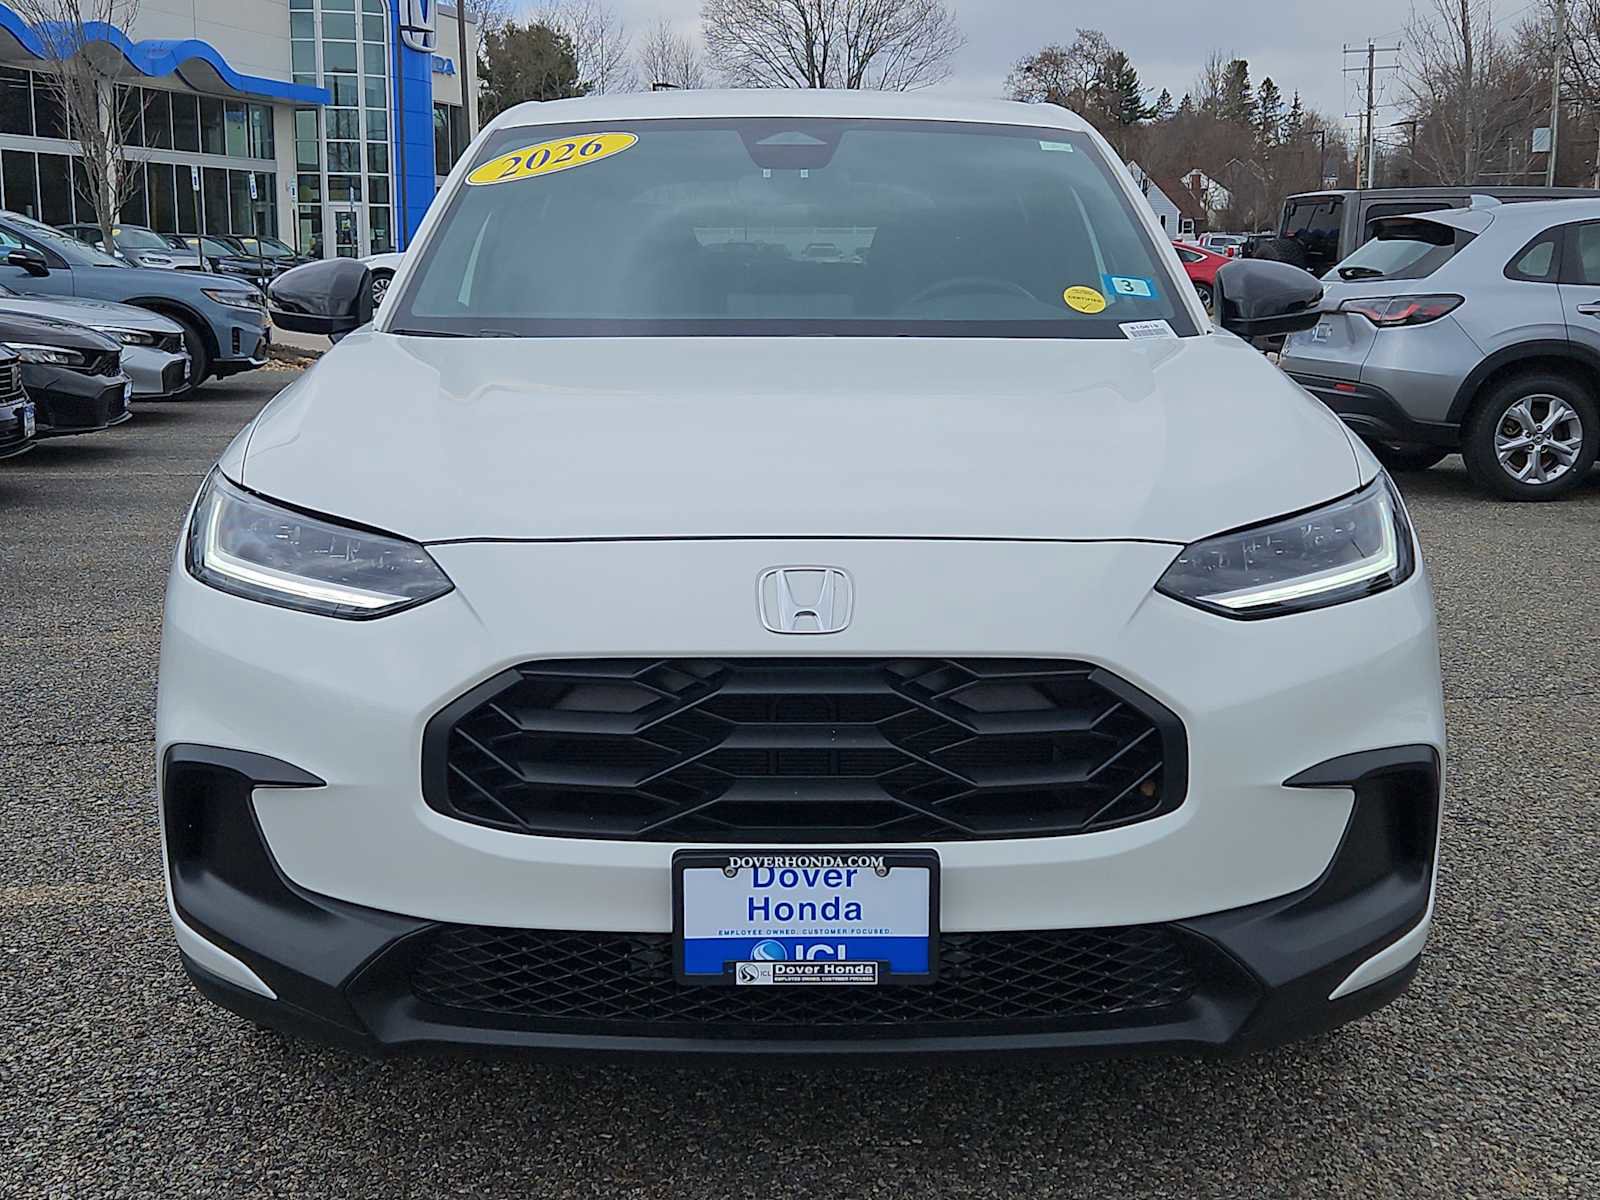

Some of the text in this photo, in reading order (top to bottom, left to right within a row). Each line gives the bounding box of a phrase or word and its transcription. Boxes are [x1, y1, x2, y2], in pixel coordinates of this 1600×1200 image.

[497, 137, 604, 179] 2026
[1121, 280, 1134, 292] 3
[729, 855, 884, 868] DOVERHONDA.COM
[752, 866, 857, 888] Dover
[747, 896, 863, 921] Honda
[718, 928, 763, 936] EMPLOYEE
[774, 964, 873, 974] Dover Honda
